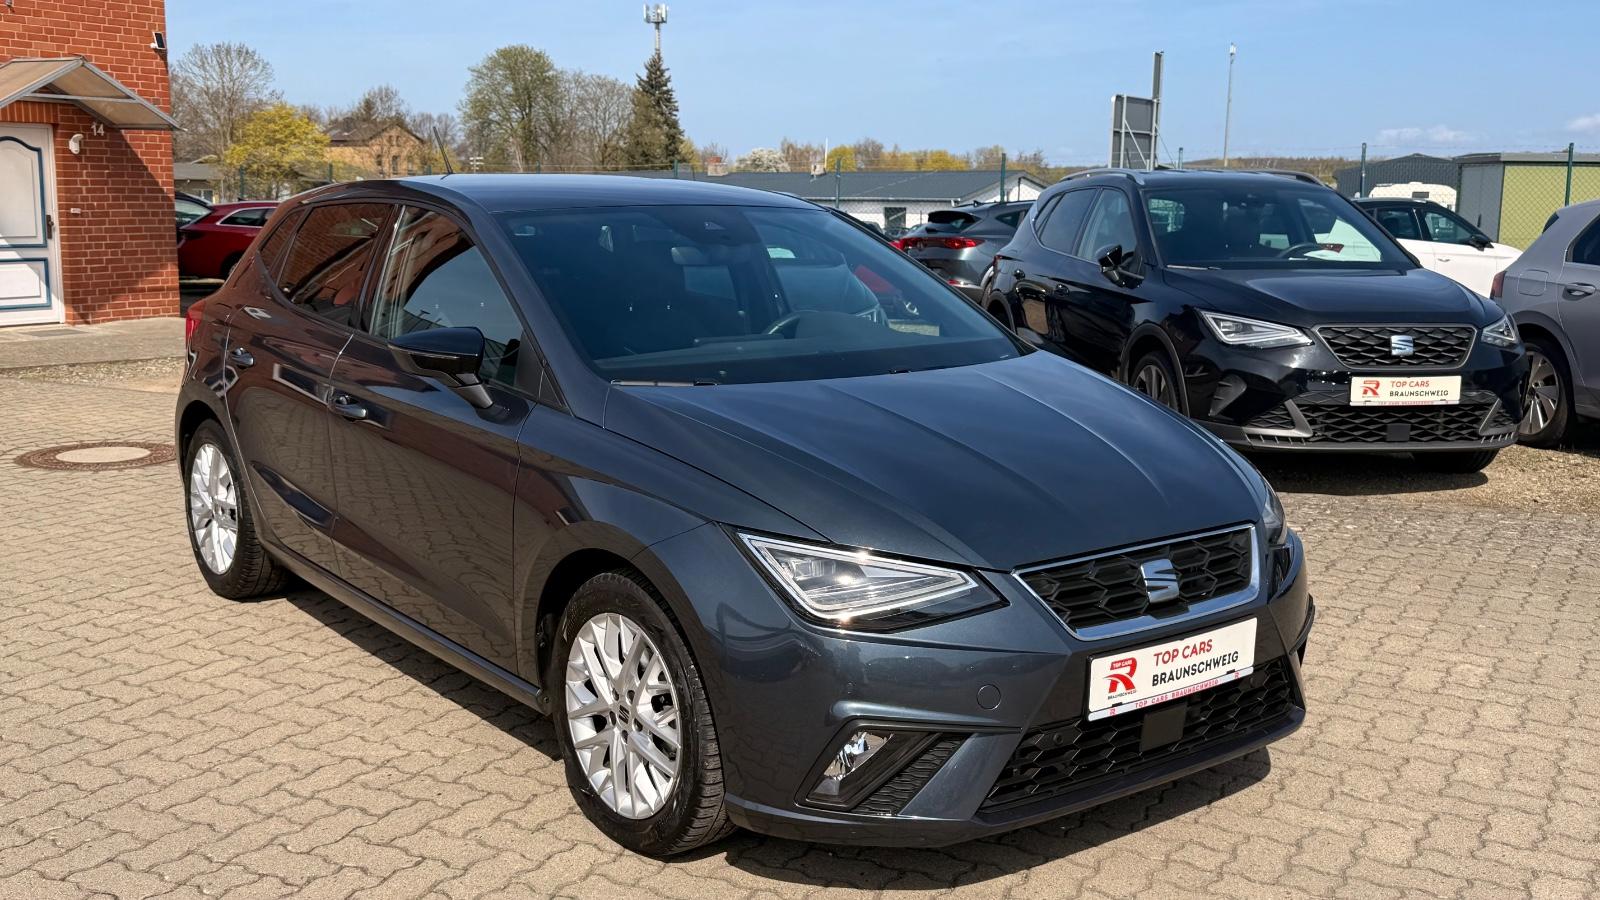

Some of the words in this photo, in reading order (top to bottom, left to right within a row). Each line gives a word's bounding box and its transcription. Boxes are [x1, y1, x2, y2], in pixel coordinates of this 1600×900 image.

[91, 121, 104, 136] 14
[1389, 389, 1449, 397] BRAUNSCHWEIG
[1390, 380, 1407, 388] TOP
[1408, 380, 1430, 388] CARS
[1153, 648, 1179, 667] TOP
[1181, 638, 1213, 659] CARS
[1152, 650, 1239, 687] BRAUNSCHWEIG
[1135, 700, 1148, 709] TOP
[1151, 694, 1169, 704] CARS
[1171, 679, 1219, 698] BRAUNSCHWEIG
